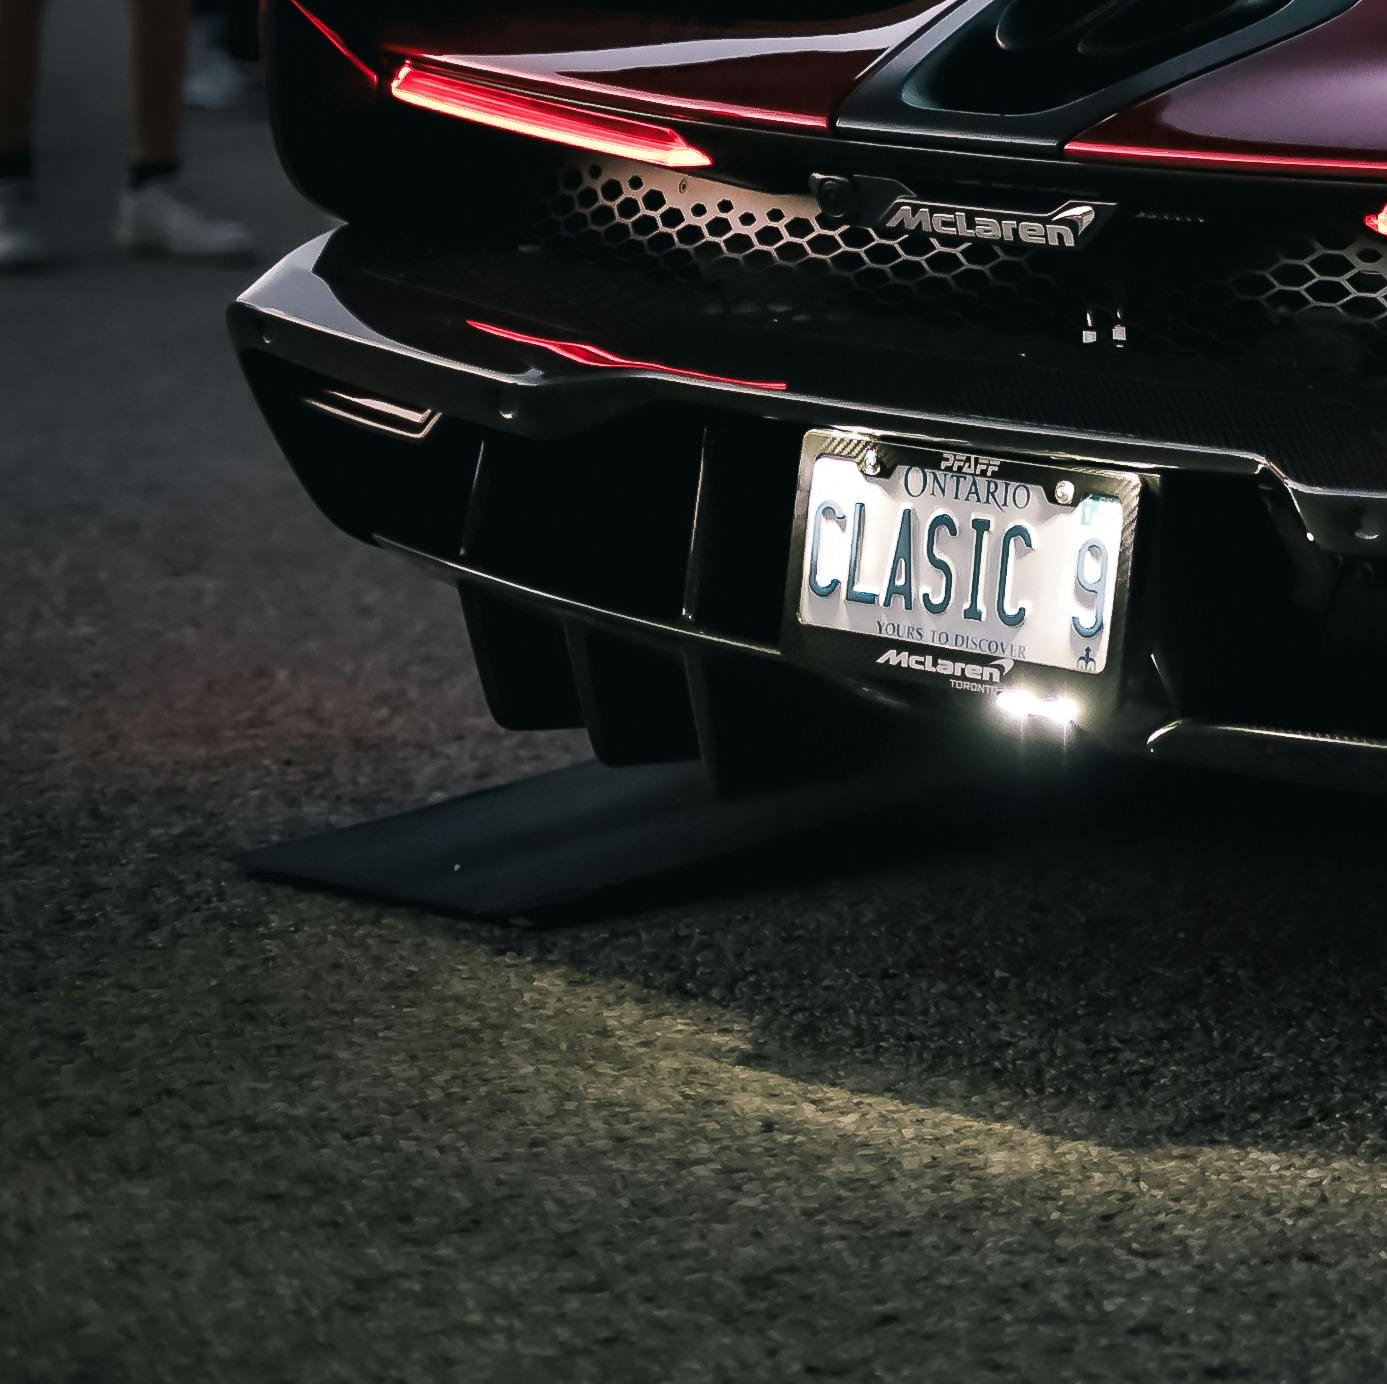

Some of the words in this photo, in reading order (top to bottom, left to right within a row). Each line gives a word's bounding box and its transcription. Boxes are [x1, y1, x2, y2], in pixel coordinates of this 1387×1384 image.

[886, 206, 1075, 247] McLaren
[941, 453, 1000, 477] PFAFF
[904, 467, 1032, 512] ONTARIO
[808, 500, 1034, 627] CLASIC
[1071, 538, 1108, 639] 9
[876, 620, 923, 641] YOURS
[930, 629, 949, 645] TO
[955, 634, 1026, 659] DISCOVER
[876, 649, 1001, 683] McLaren
